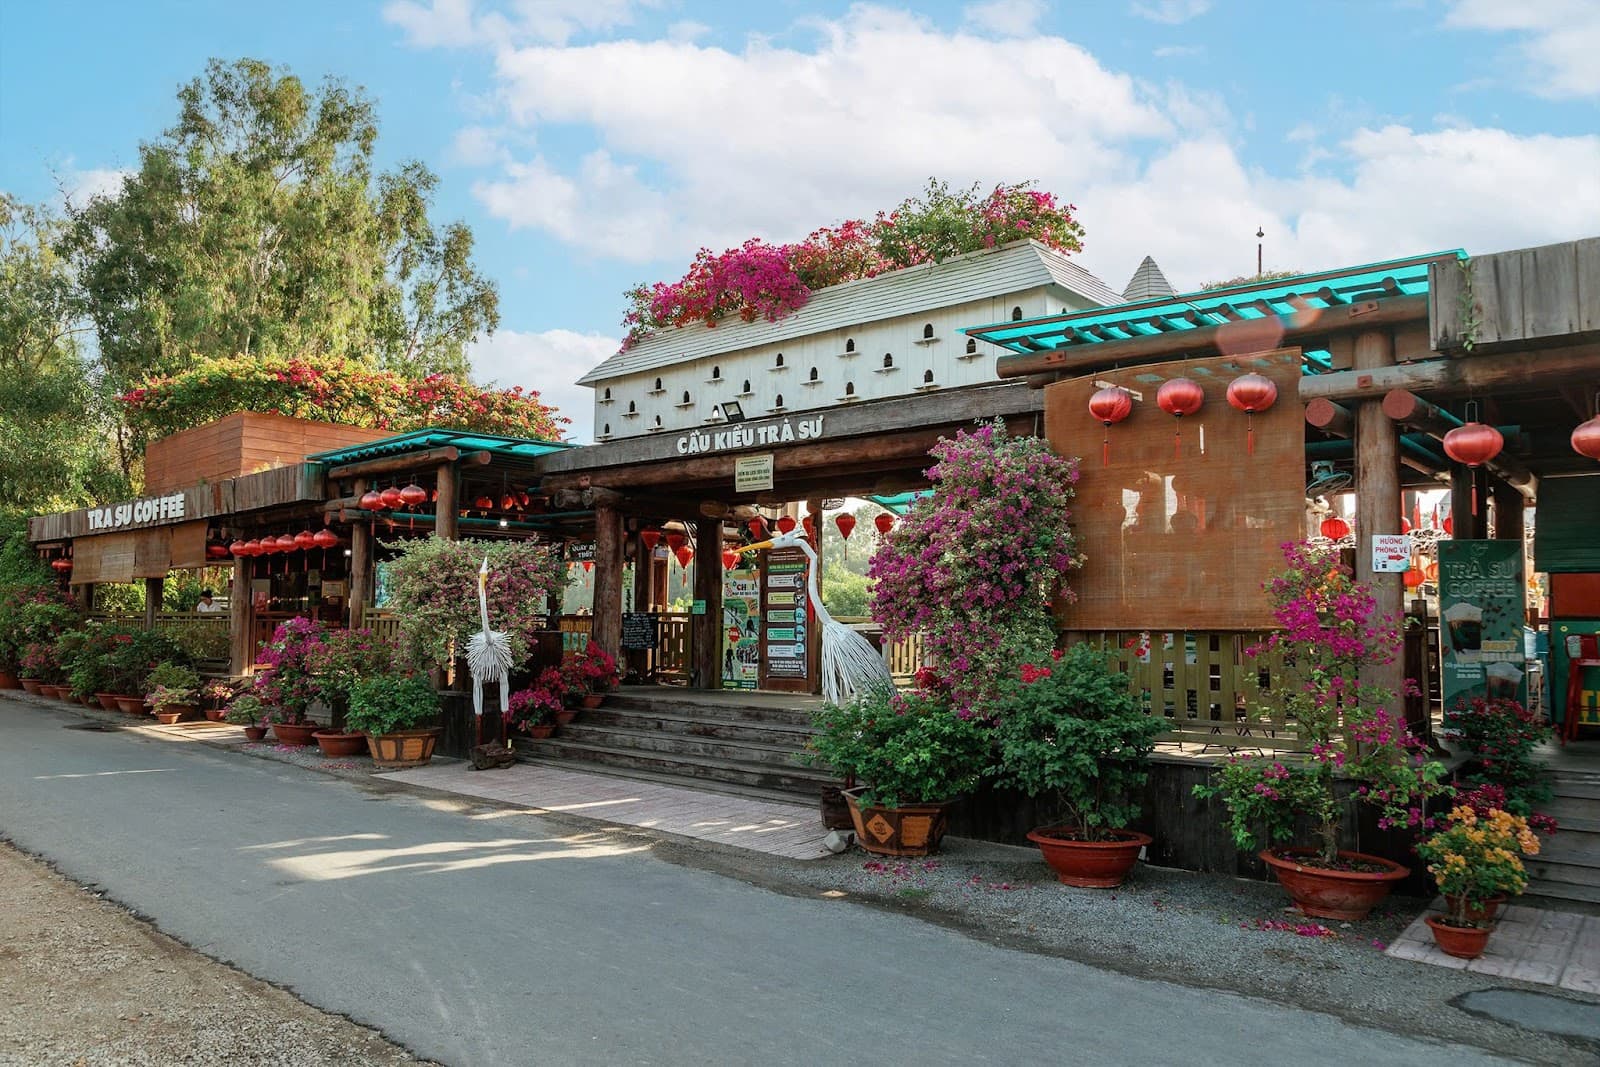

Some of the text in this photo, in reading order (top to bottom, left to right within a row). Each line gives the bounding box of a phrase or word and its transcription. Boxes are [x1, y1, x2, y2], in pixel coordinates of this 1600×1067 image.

[677, 429, 710, 454] CẦU
[714, 424, 754, 450] KIỀU
[798, 415, 824, 440] SƯ
[134, 493, 184, 523] COFFEE
[1446, 580, 1517, 598] COFFEE
